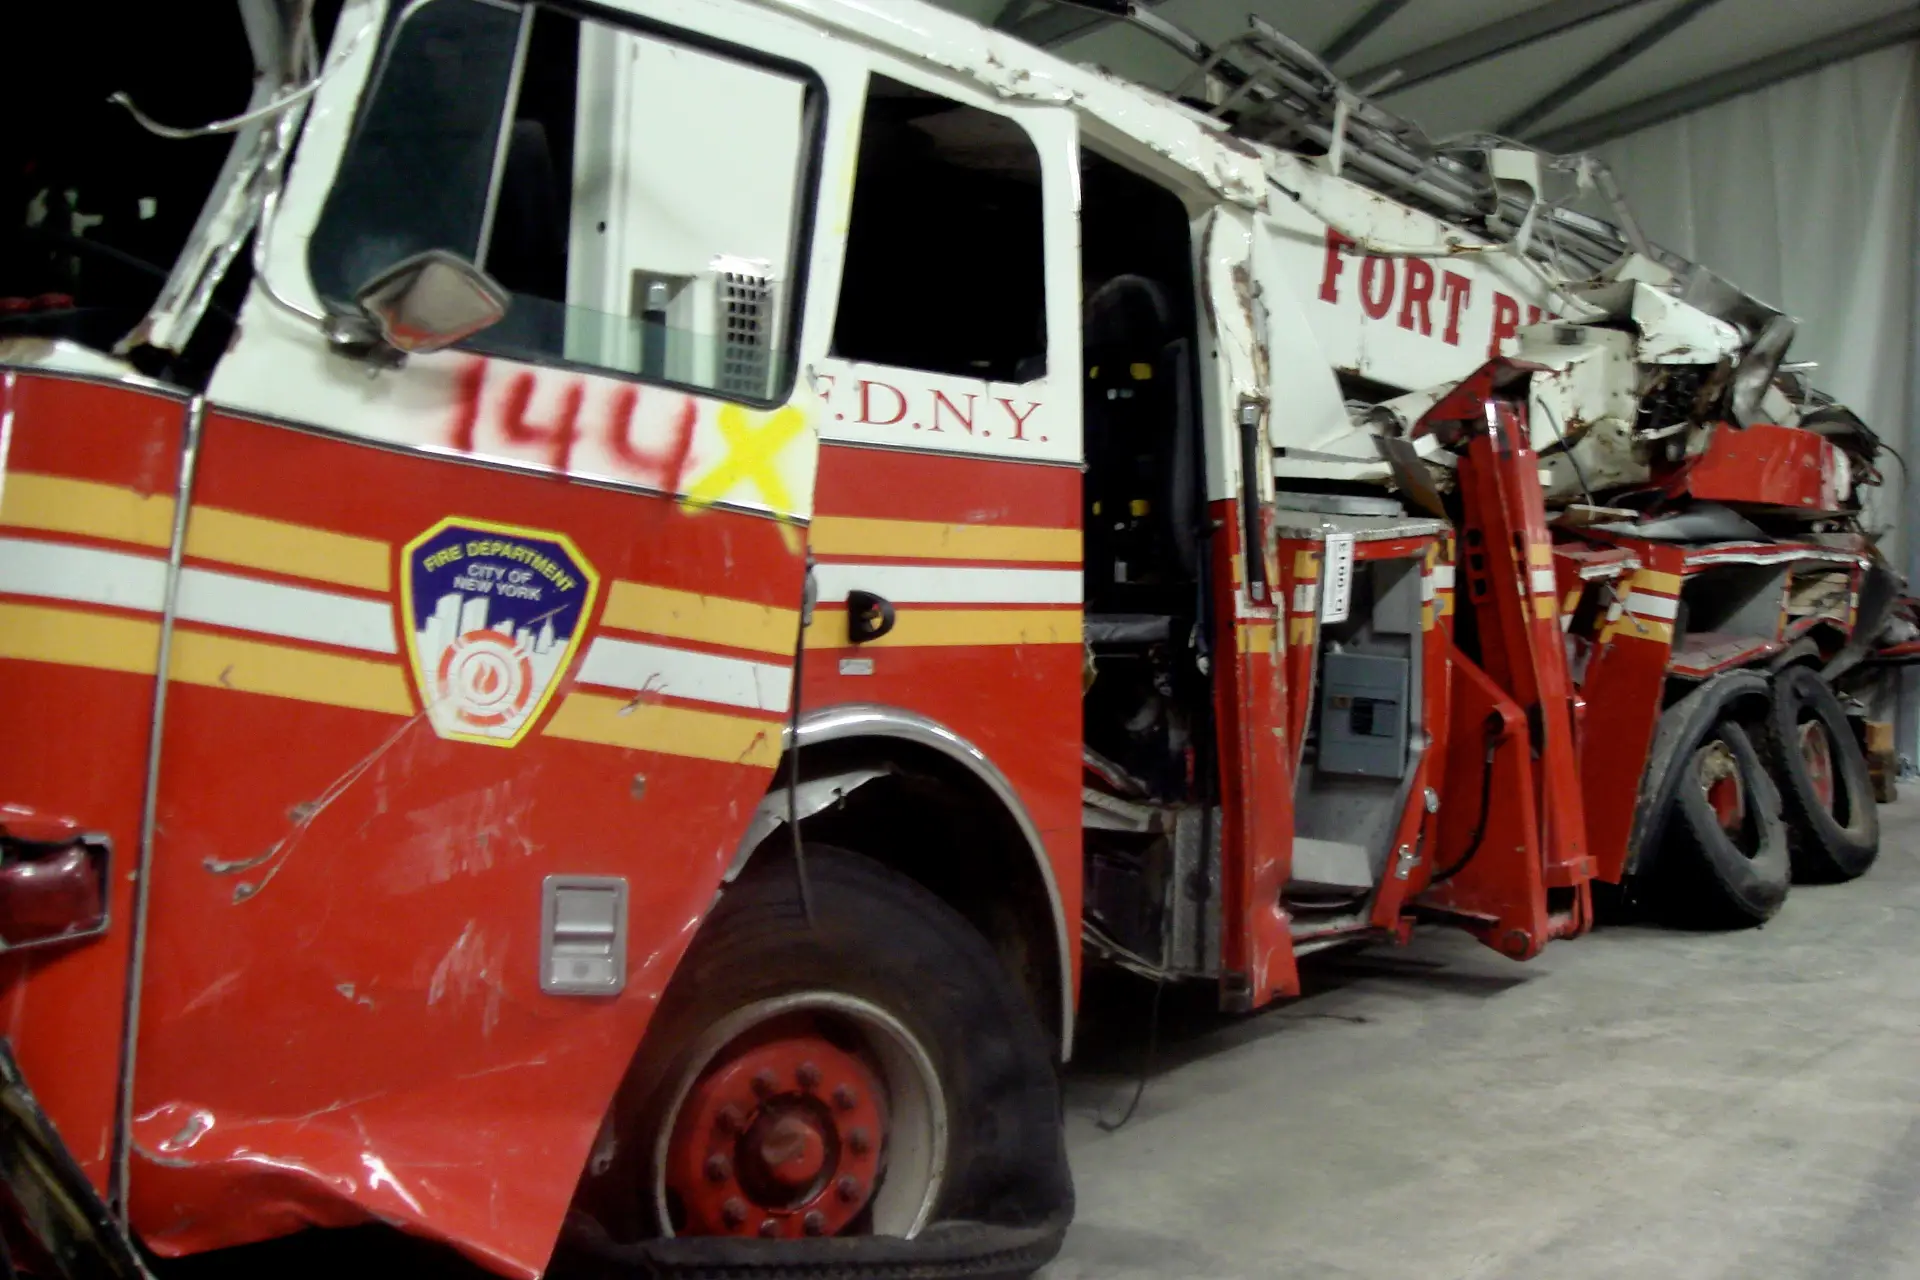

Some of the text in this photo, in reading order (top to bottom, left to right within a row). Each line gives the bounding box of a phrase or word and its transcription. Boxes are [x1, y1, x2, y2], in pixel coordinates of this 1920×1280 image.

[1318, 223, 1471, 347] FORT
[446, 355, 697, 500] 144
[423, 539, 577, 592] FIRE DEPARTMENT
[453, 575, 542, 601] NEW YORK
[467, 562, 533, 584] CITY OF
